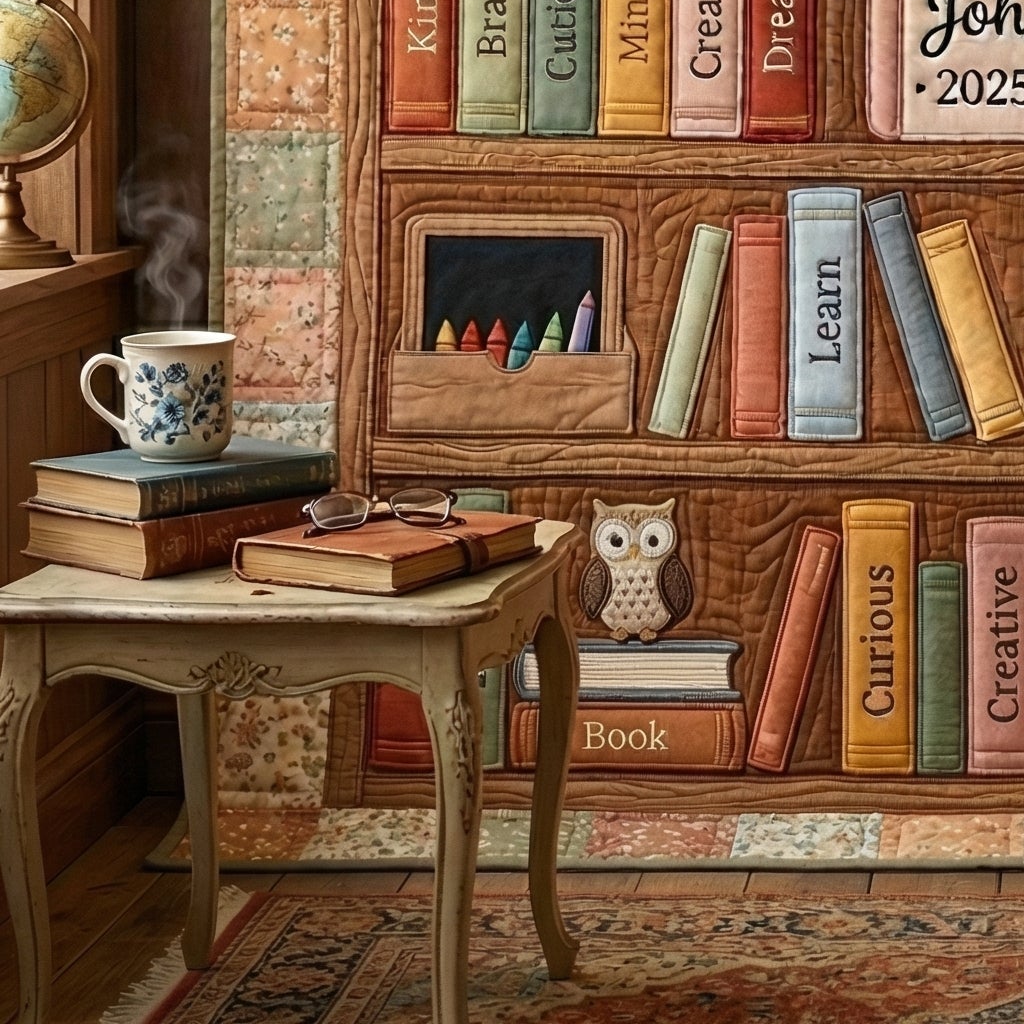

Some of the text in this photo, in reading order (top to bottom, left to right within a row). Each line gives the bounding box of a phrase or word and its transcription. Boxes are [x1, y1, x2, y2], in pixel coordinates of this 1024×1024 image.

[808, 256, 842, 365] Learn
[860, 564, 895, 717] Curious
[986, 566, 1021, 723] Creative
[582, 720, 669, 751] Book
